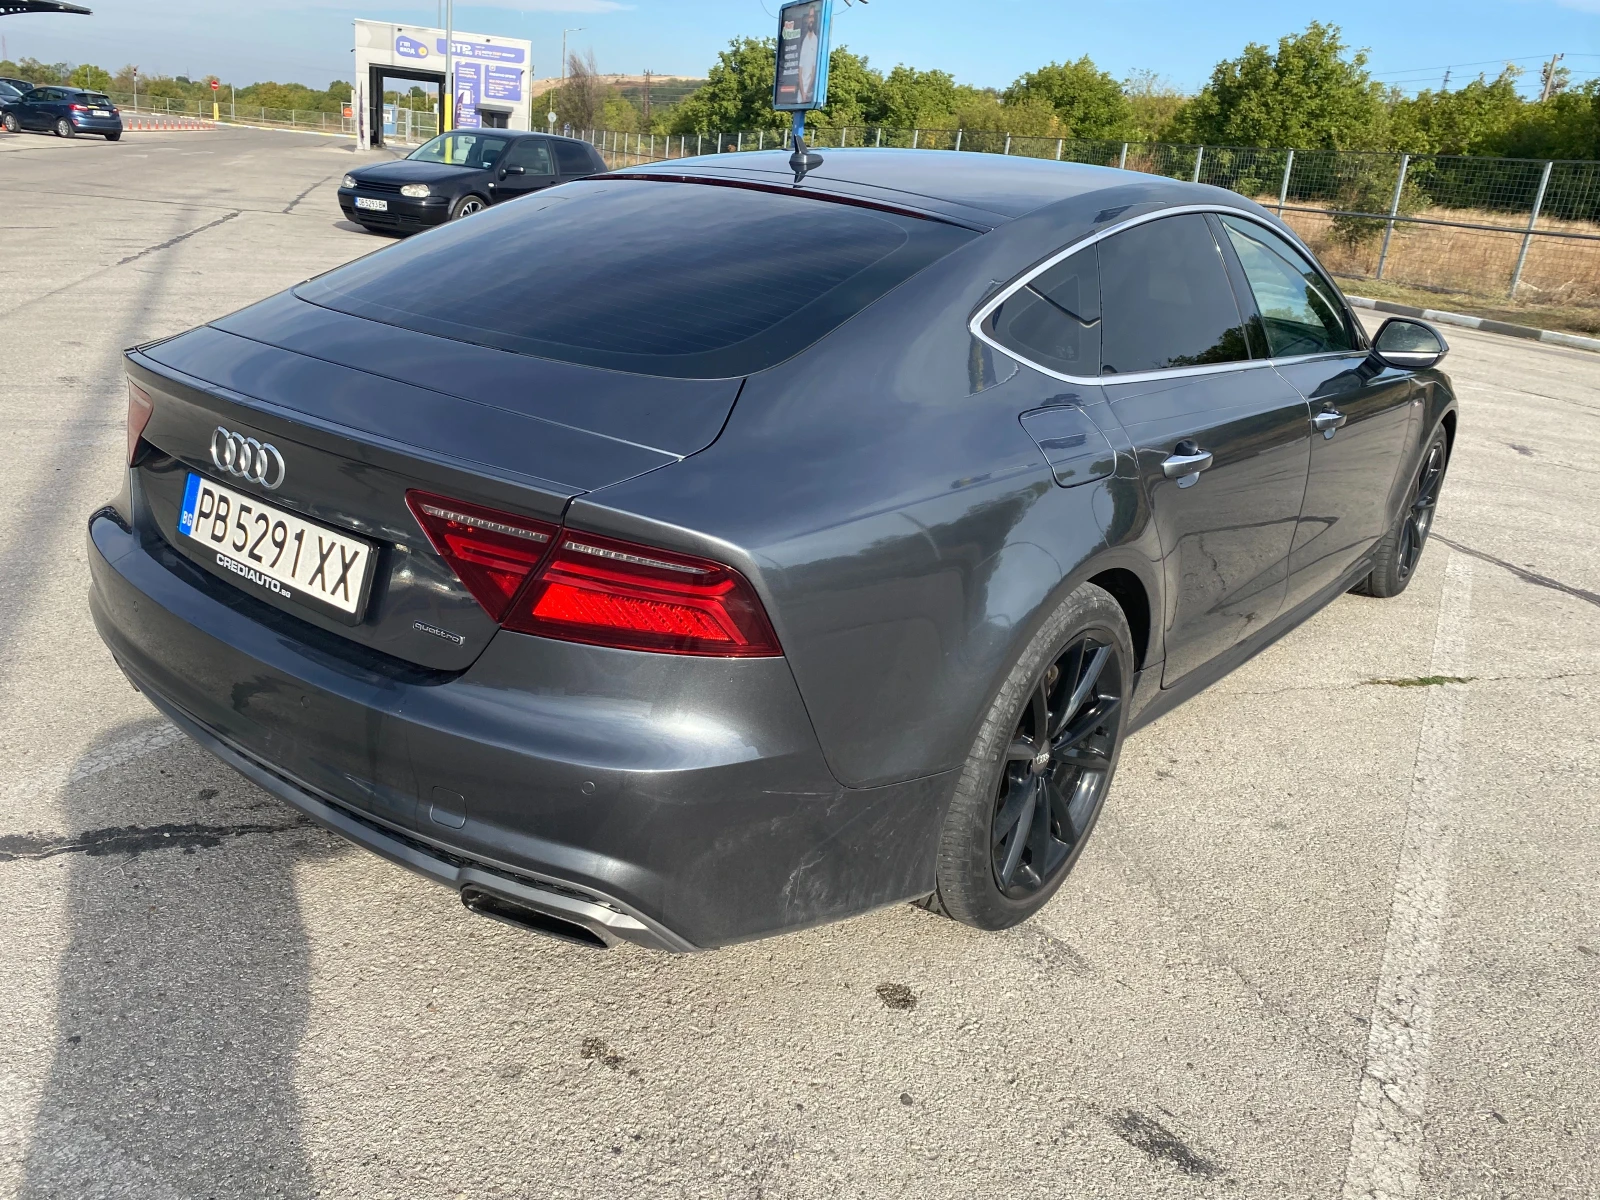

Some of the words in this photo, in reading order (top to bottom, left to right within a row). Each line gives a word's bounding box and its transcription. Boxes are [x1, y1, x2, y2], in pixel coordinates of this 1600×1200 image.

[183, 511, 193, 526] BG
[195, 487, 231, 544] PB
[232, 503, 306, 579] 5291
[308, 535, 360, 603] XX
[415, 622, 459, 642] quattro
